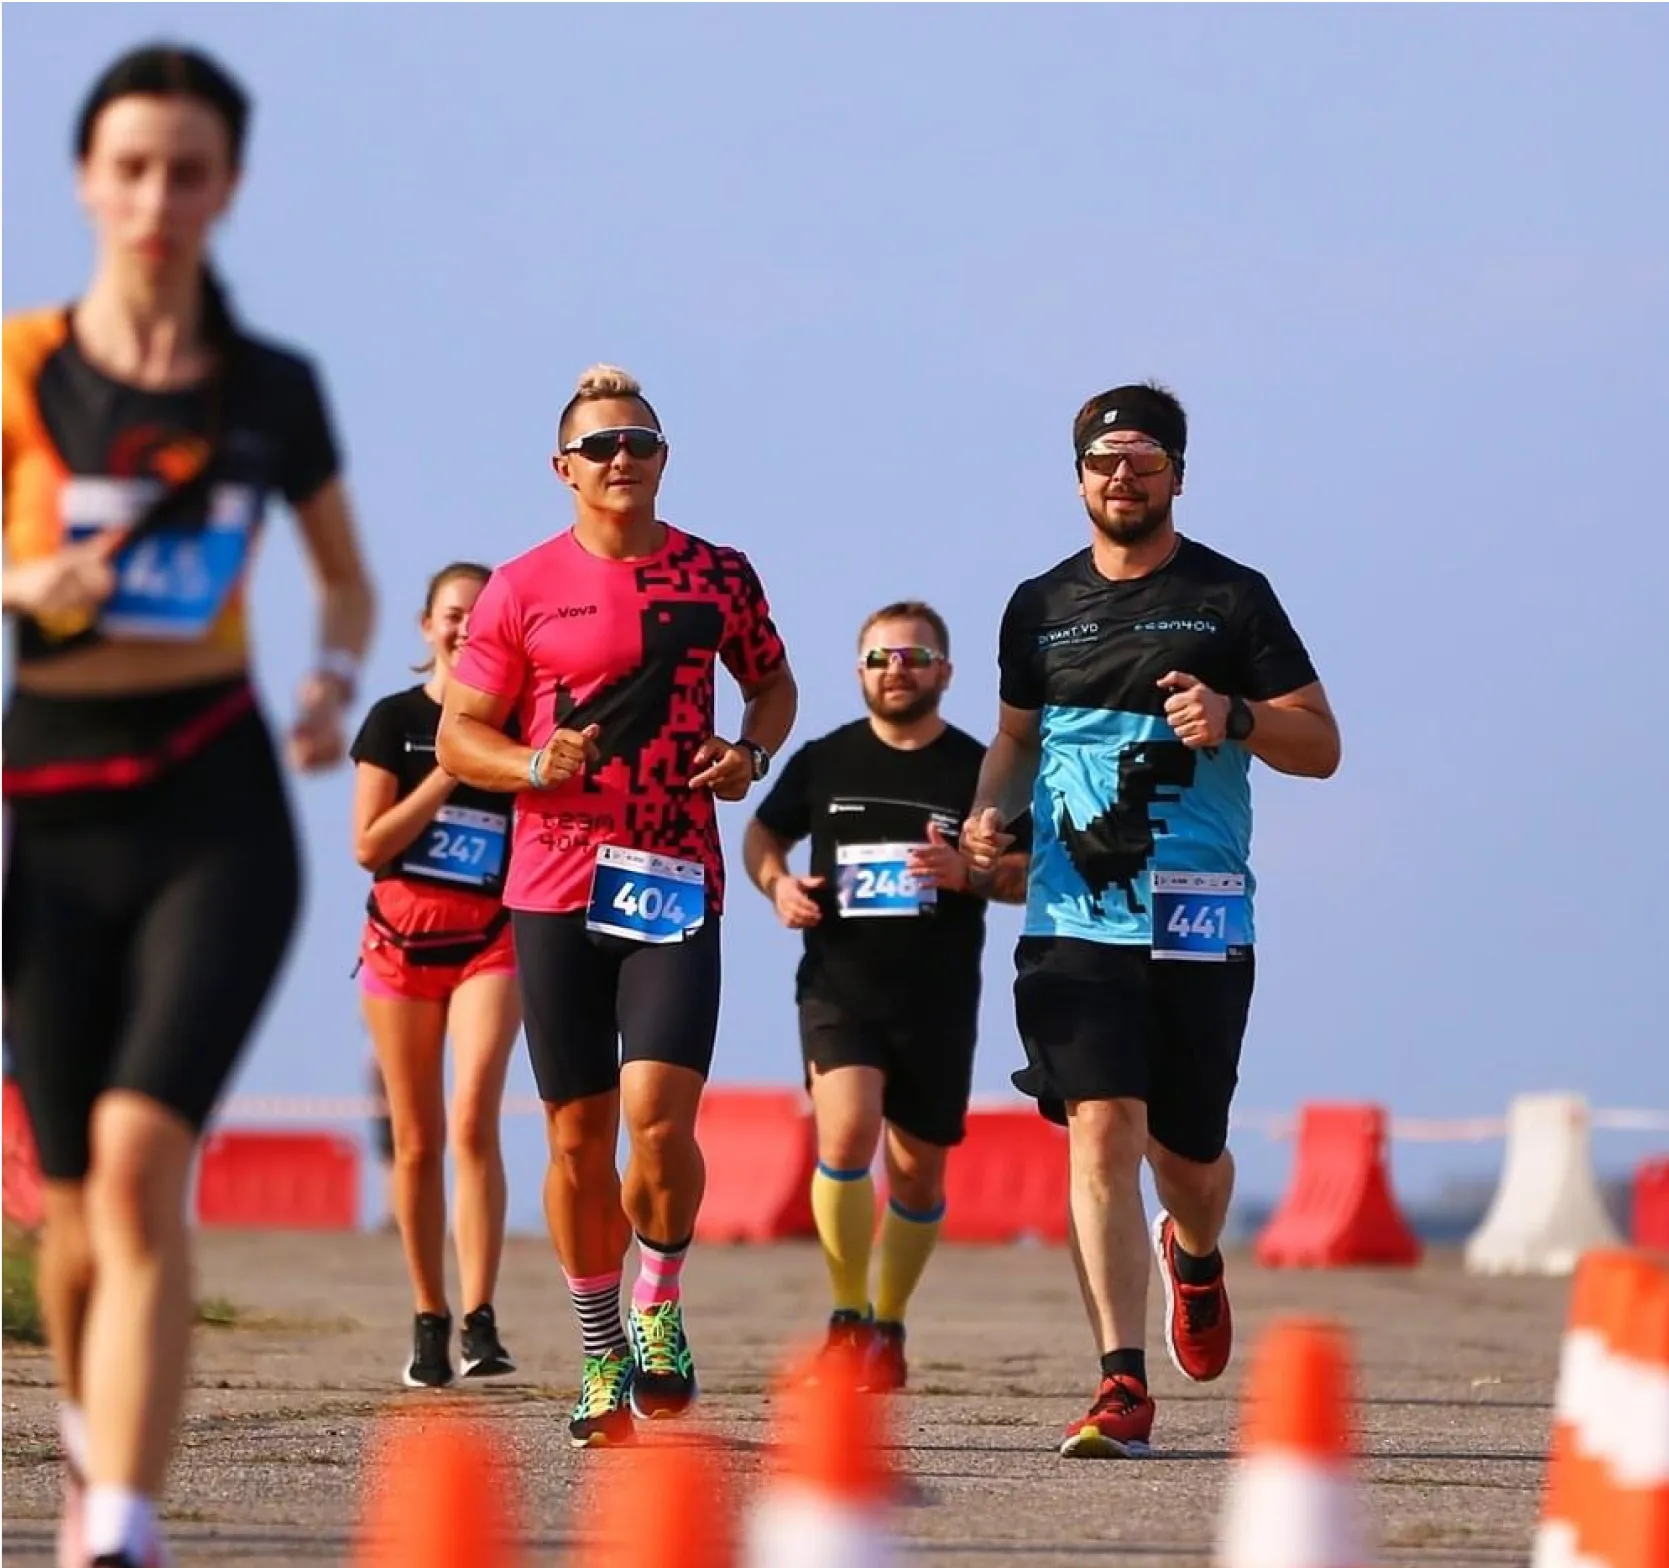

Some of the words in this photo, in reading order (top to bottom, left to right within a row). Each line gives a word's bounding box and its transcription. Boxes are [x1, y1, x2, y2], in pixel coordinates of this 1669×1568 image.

[557, 605, 598, 618] Vova
[428, 829, 487, 864] 247
[855, 868, 918, 899] 248
[613, 882, 684, 924] 404
[1167, 904, 1227, 939] 441
